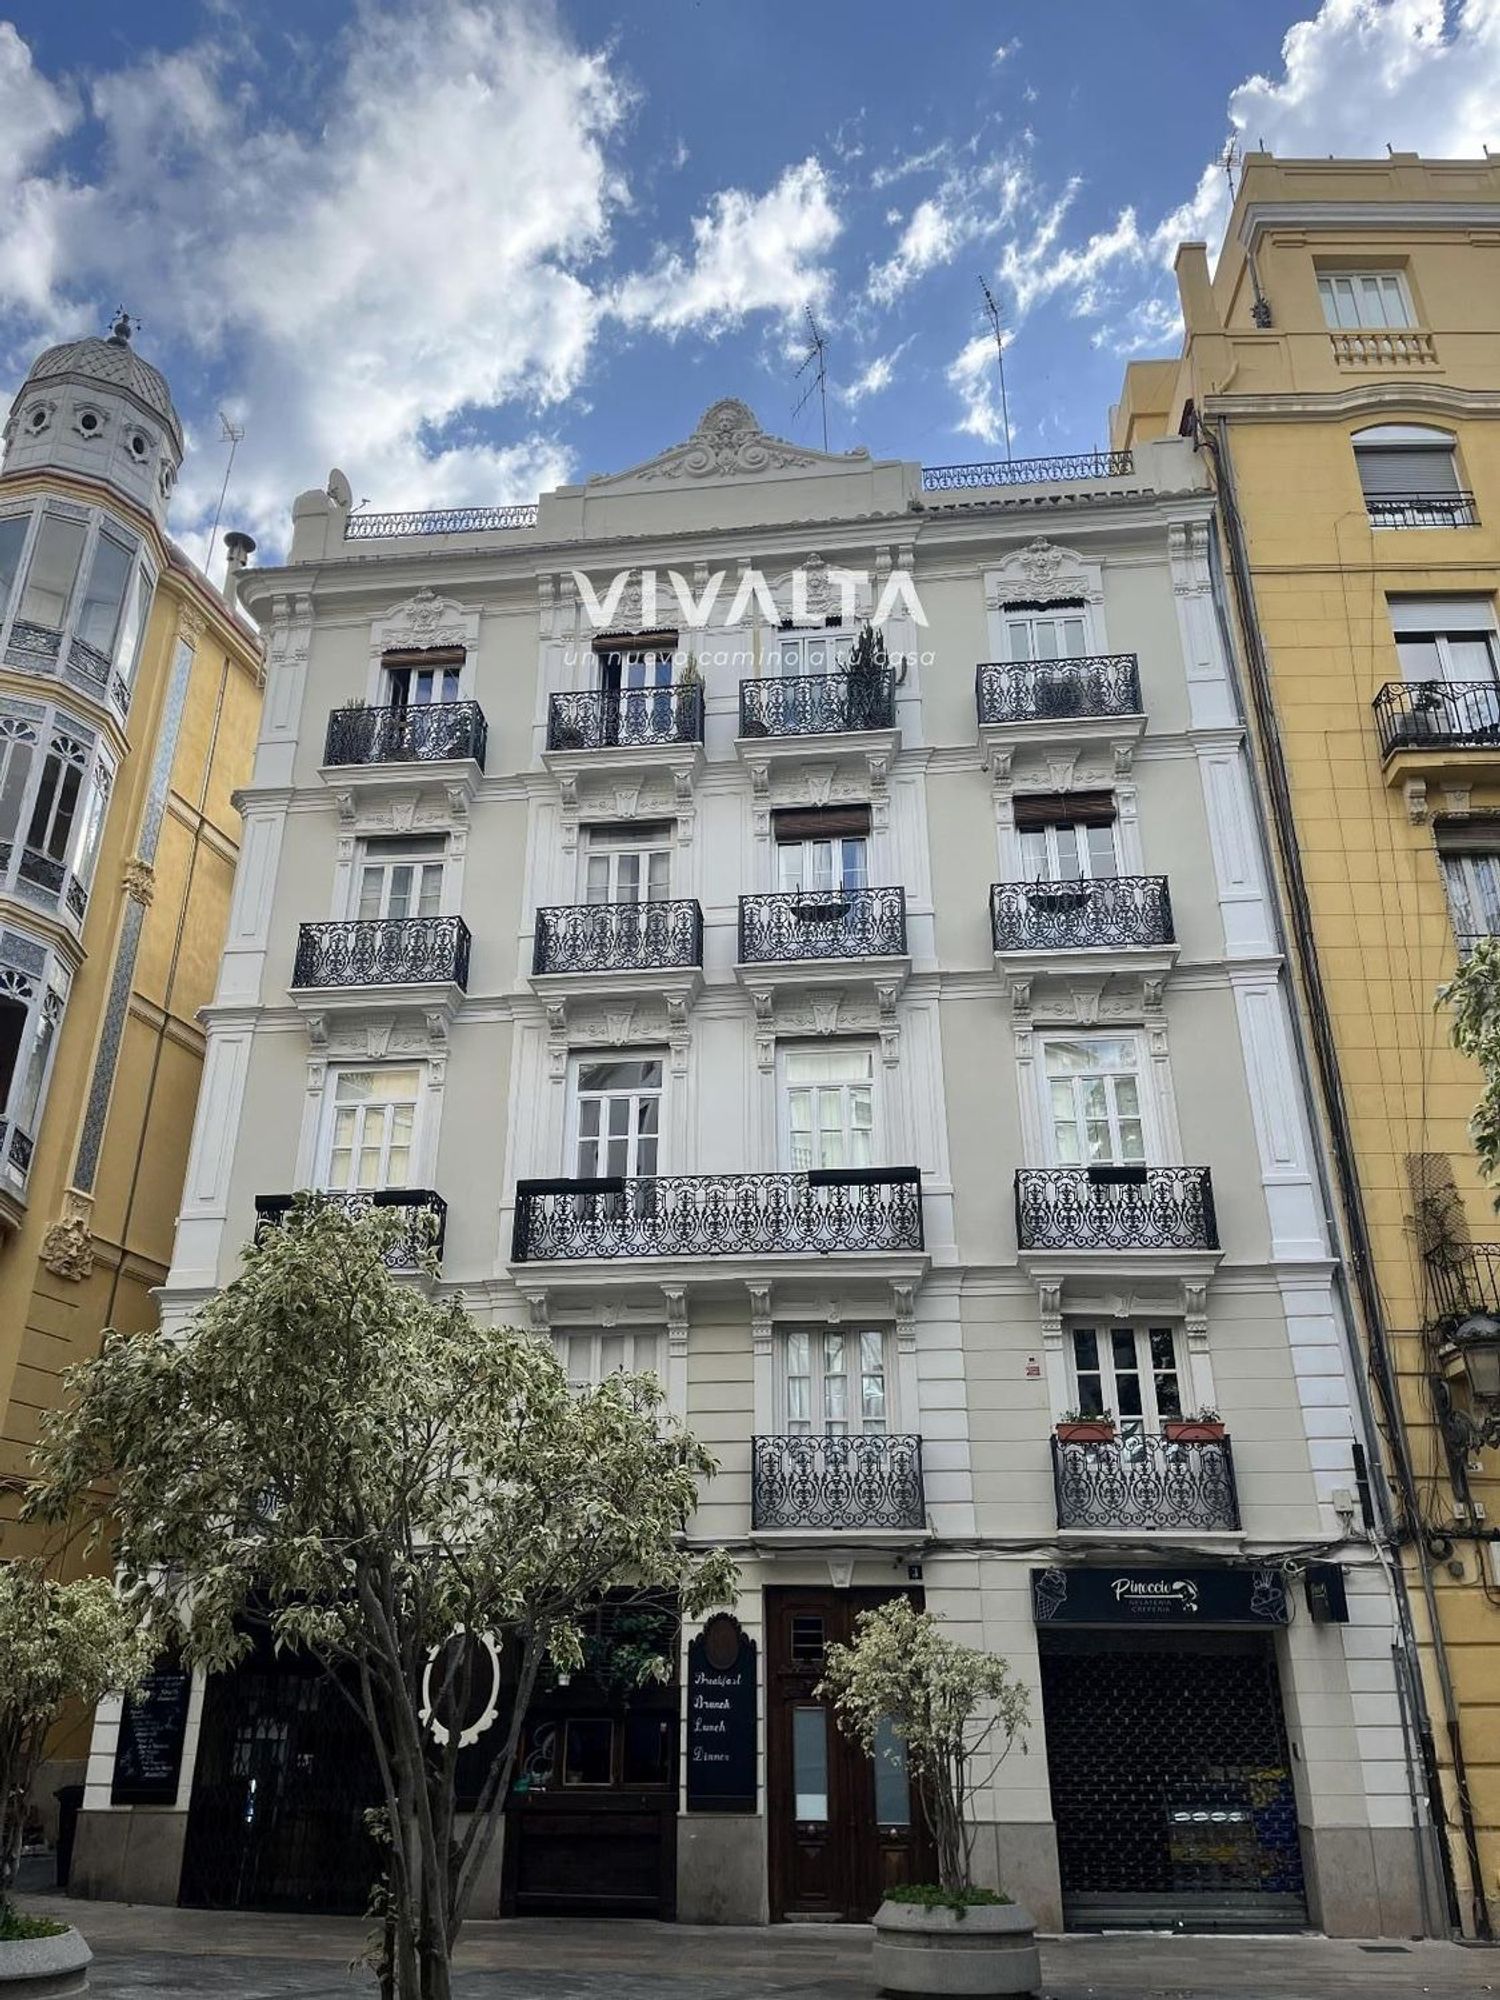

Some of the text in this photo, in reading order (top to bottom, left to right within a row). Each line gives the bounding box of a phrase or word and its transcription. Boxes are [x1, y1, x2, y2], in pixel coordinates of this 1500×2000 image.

[693, 1694, 730, 1709] Brunch
[694, 1717, 726, 1732] Lunch
[693, 1747, 730, 1761] Dinner
